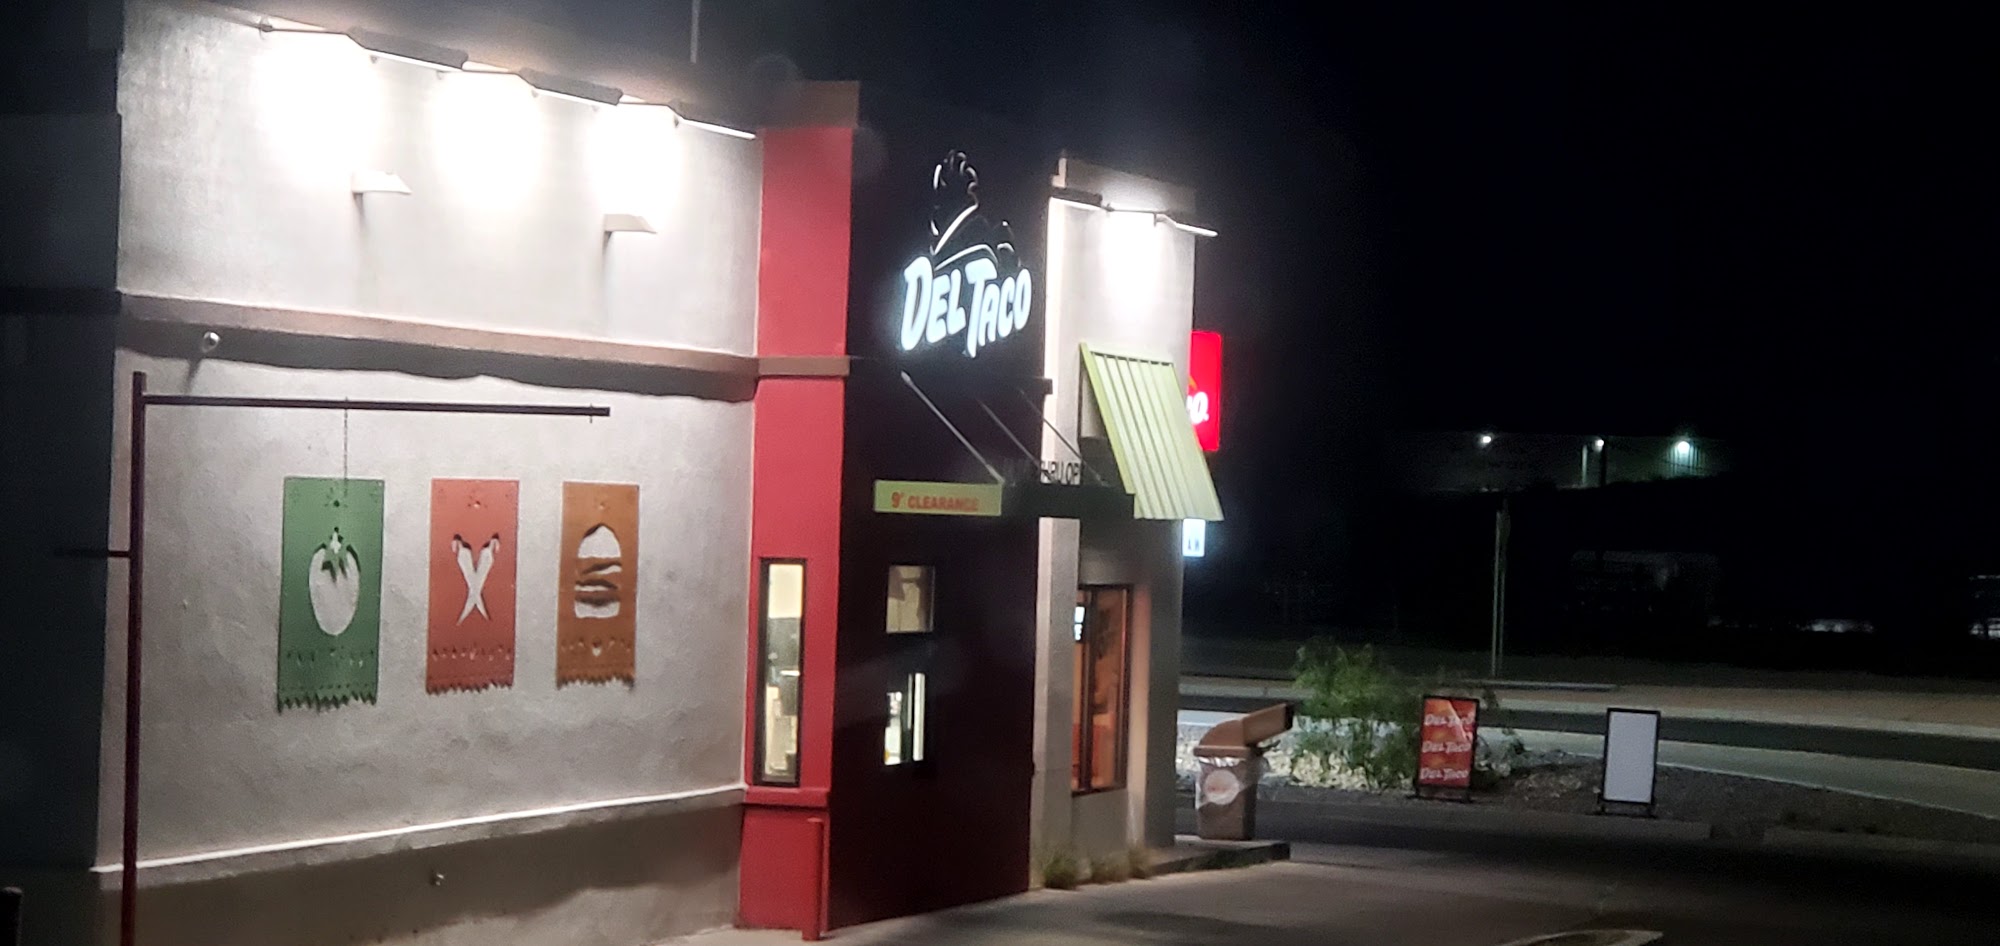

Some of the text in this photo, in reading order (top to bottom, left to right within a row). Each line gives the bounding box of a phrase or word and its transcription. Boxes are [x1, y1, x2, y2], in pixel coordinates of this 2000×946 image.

[900, 256, 1032, 358] DEL TACO
[907, 495, 979, 512] CLEARANCE
[1421, 740, 1471, 754] DEL TACO
[1420, 767, 1469, 781] DEL TACO
